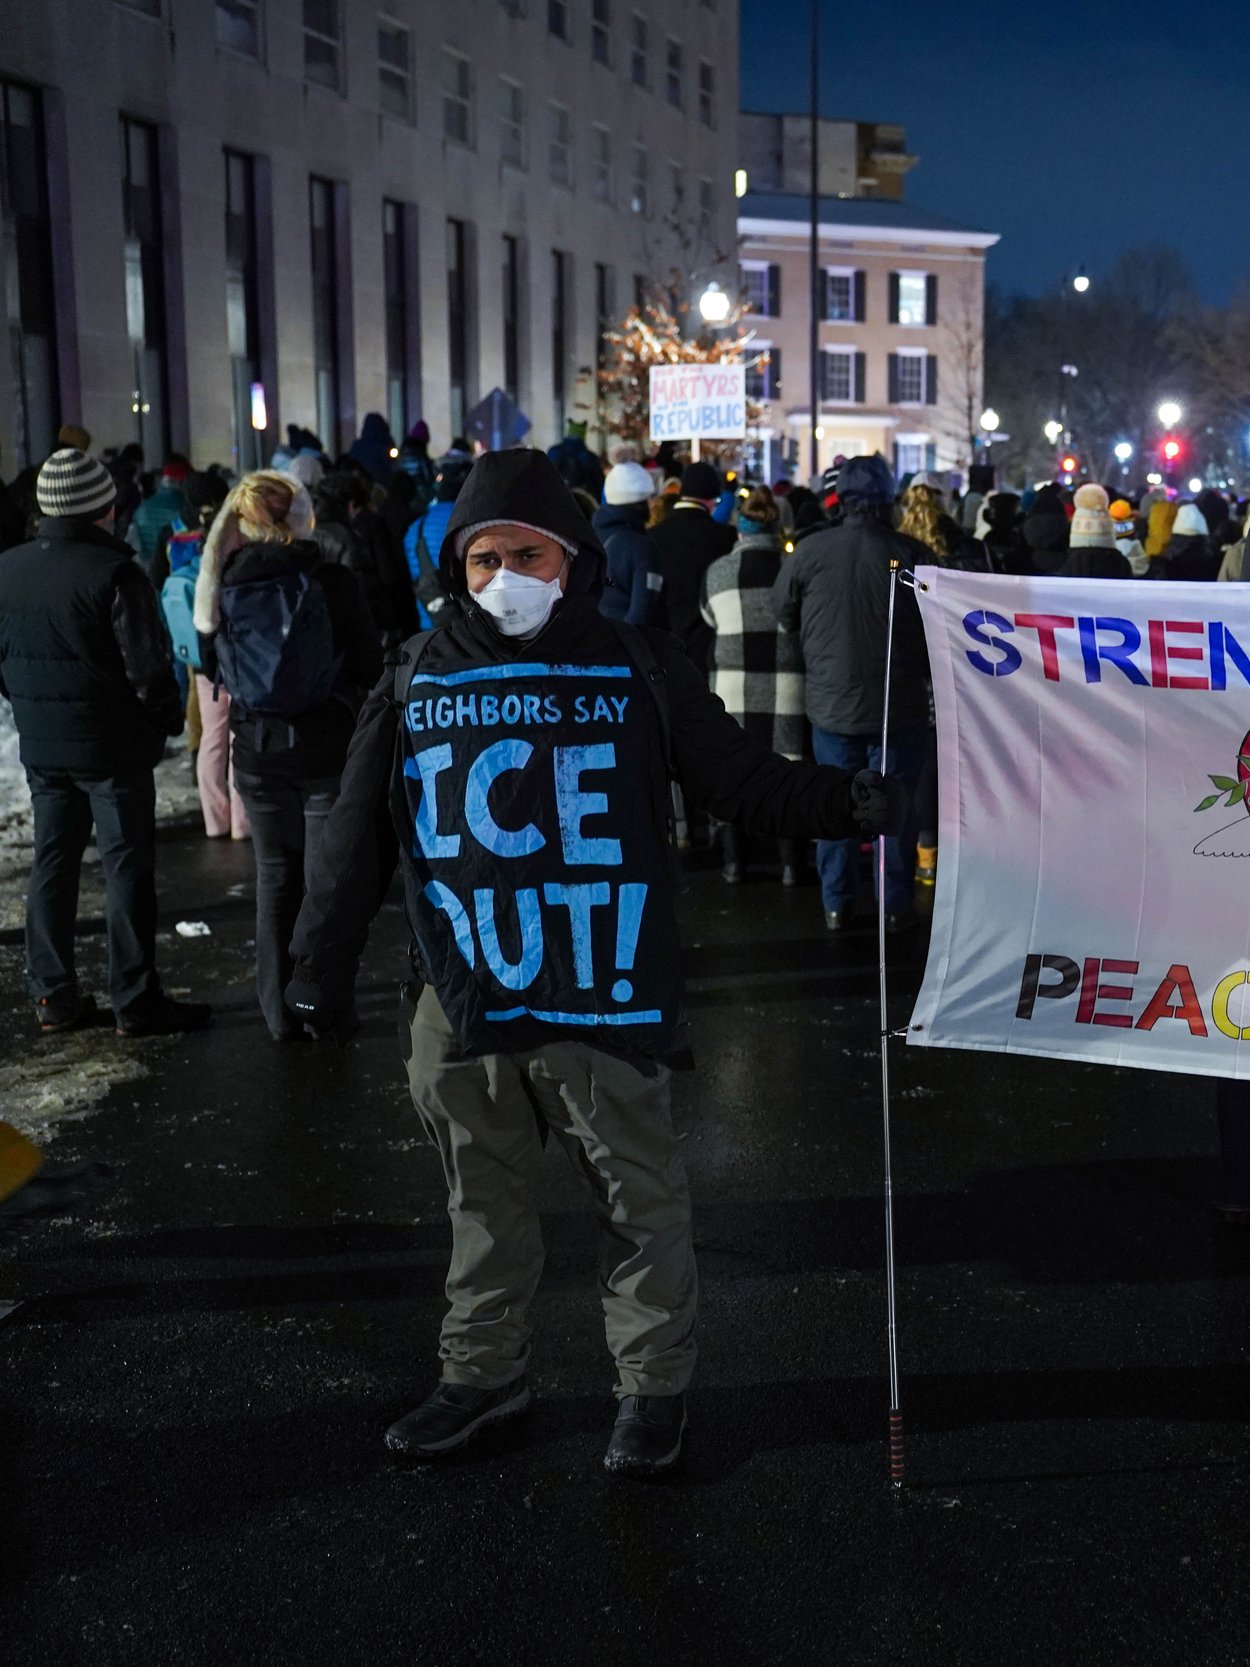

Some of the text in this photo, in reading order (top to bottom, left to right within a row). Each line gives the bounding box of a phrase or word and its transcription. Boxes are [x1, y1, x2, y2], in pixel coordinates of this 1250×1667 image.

[653, 374, 739, 404] MARTYRS
[653, 403, 743, 436] REPUBLIC
[574, 696, 630, 724] SAY
[403, 738, 623, 865] ICE
